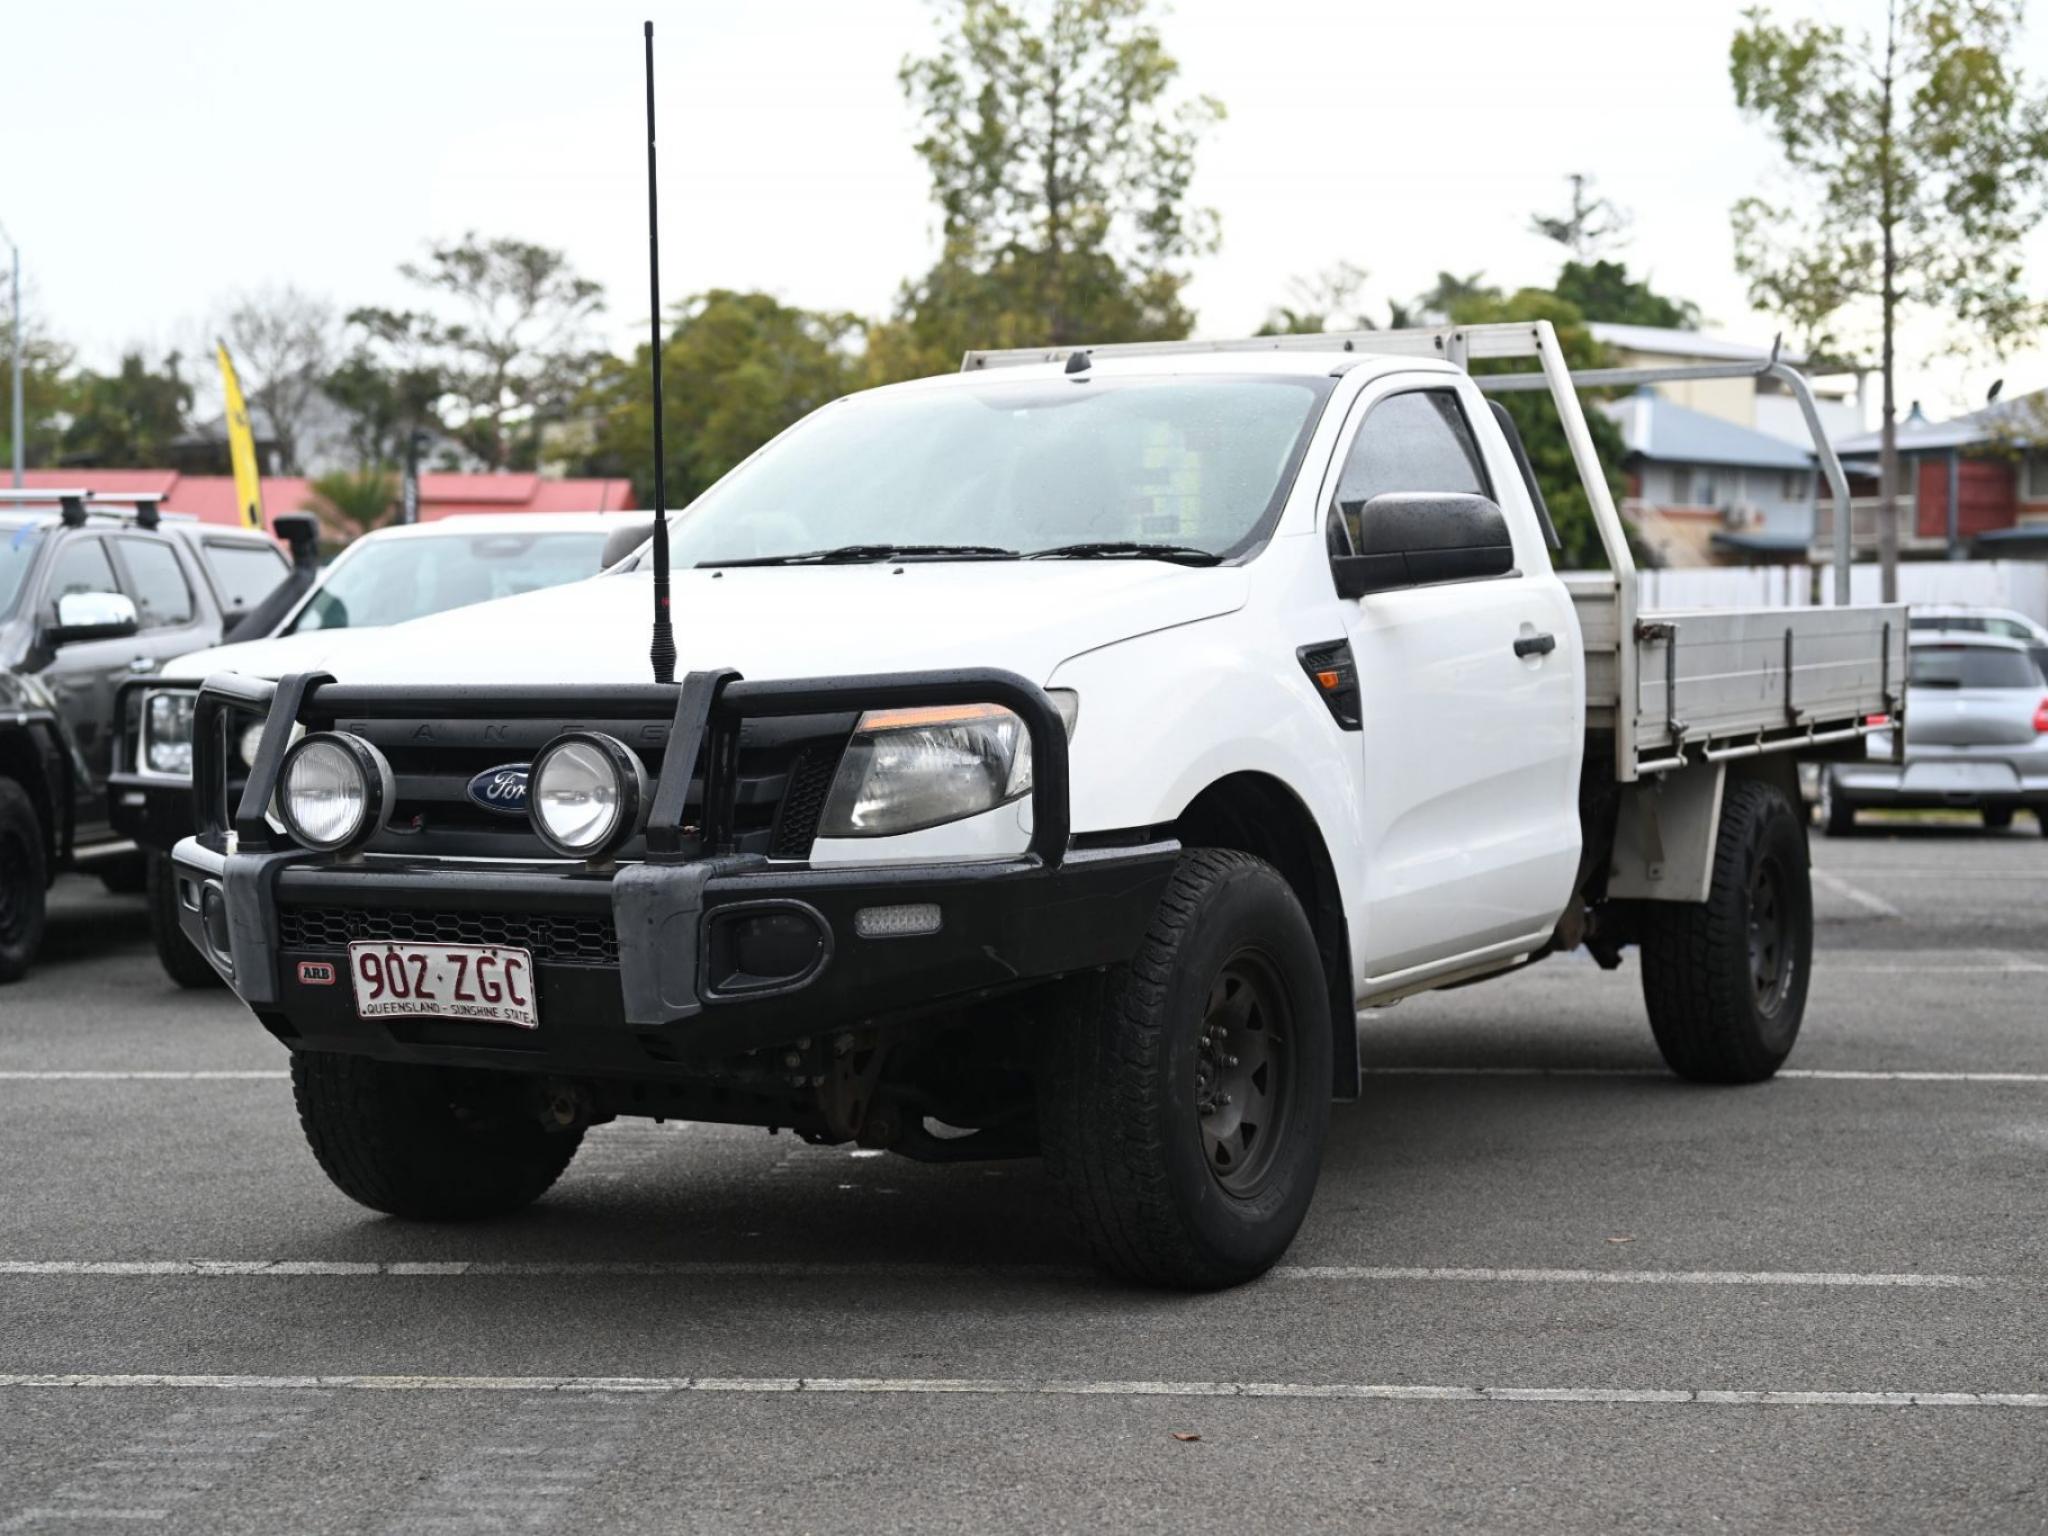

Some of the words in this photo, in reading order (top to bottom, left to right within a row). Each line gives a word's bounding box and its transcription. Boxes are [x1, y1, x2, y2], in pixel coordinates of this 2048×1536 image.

[486, 770, 529, 800] For
[303, 966, 331, 980] ARB
[359, 952, 436, 1000] 902
[446, 954, 526, 1007] ZGC
[367, 1002, 441, 1015] QUEENSLAND
[450, 1004, 500, 1018] SUNSHINE
[505, 1008, 530, 1024] STATE
